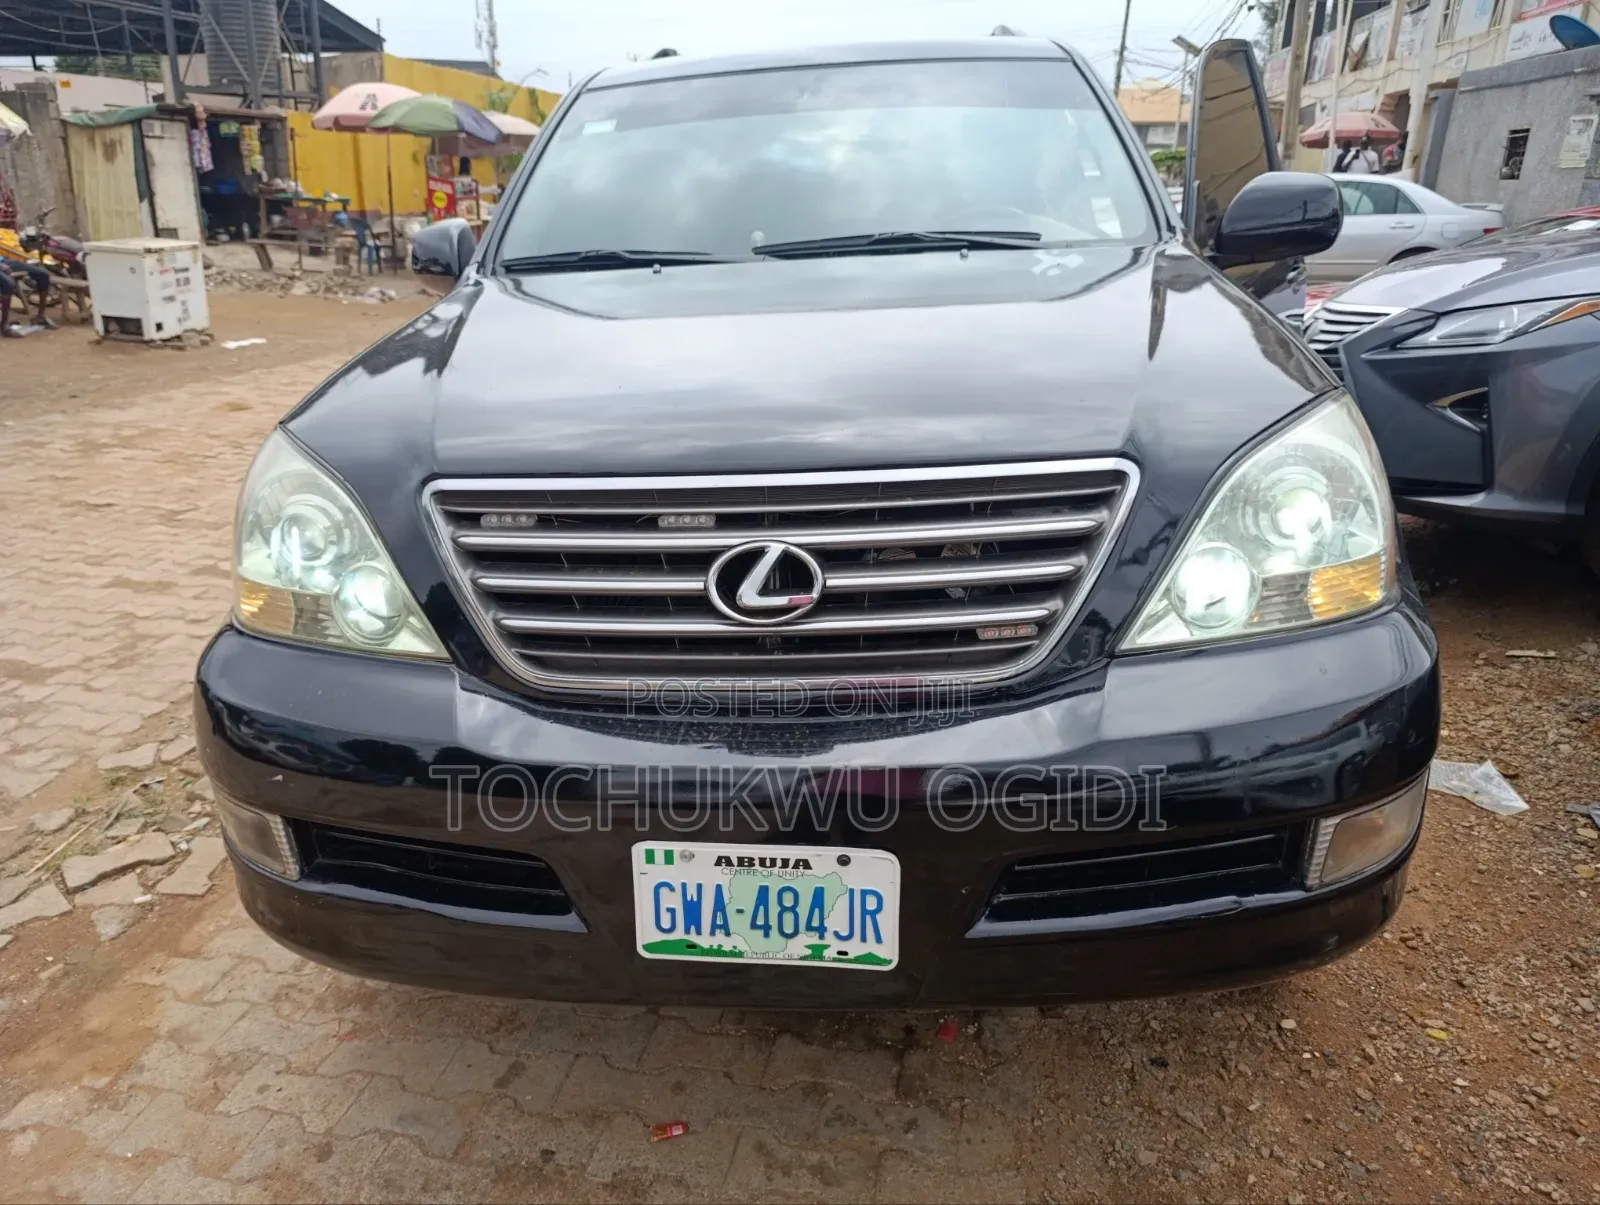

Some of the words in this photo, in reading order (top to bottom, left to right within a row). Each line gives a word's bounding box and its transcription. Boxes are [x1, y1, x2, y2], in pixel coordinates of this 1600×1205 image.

[713, 855, 813, 870] ABUJA
[721, 867, 758, 876] CENTRE
[761, 869, 775, 877] OF
[778, 870, 806, 878] UNITY
